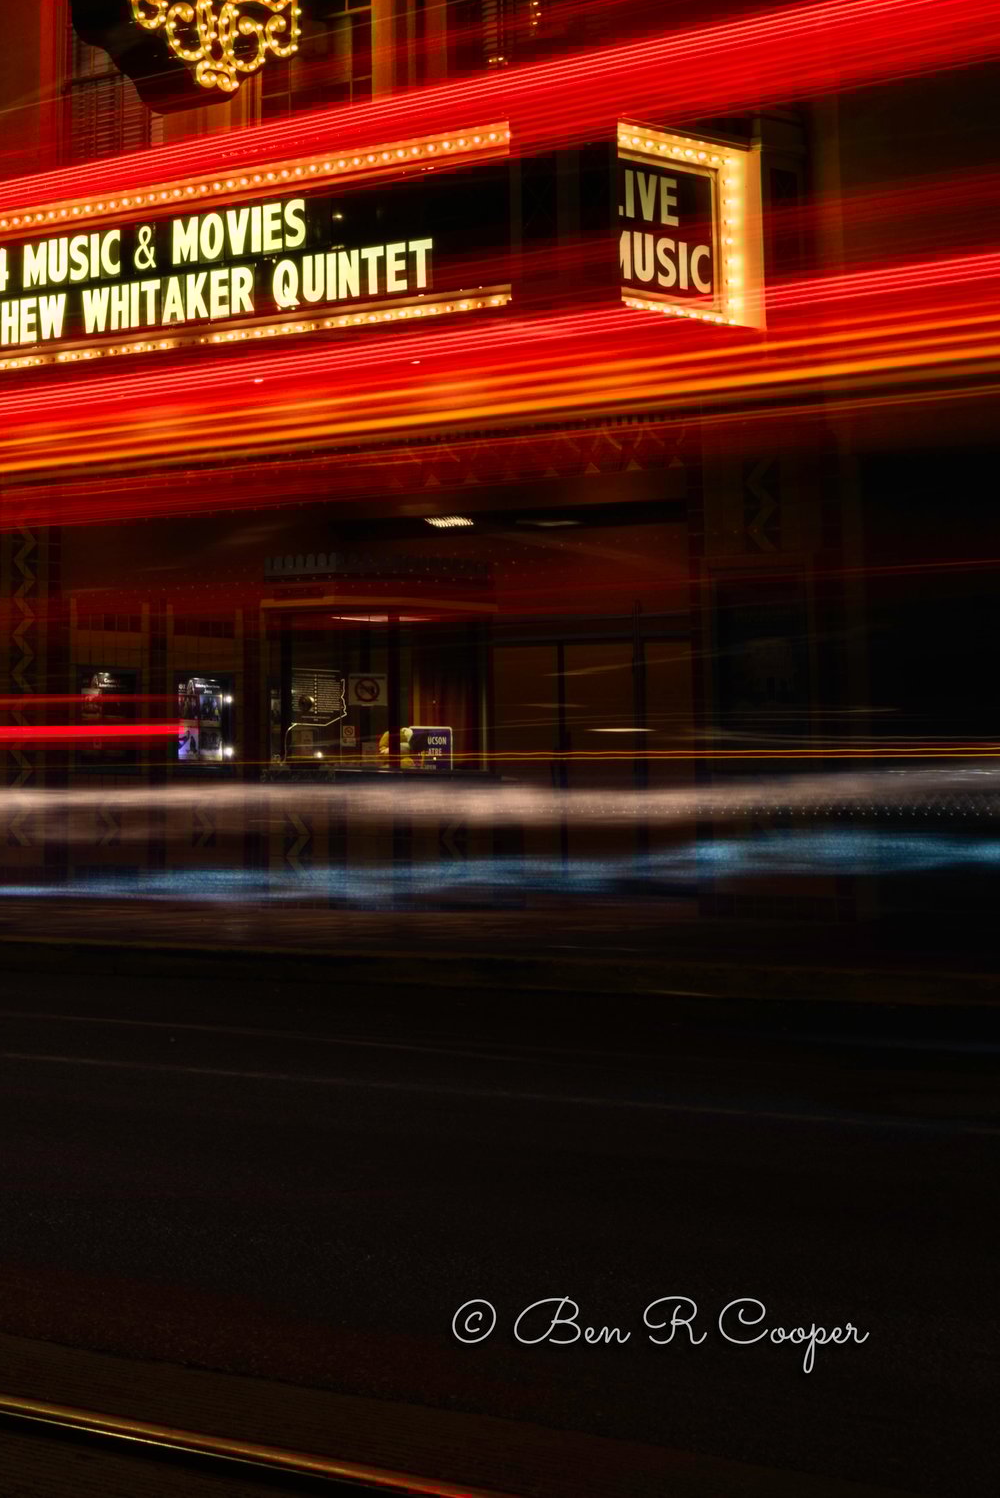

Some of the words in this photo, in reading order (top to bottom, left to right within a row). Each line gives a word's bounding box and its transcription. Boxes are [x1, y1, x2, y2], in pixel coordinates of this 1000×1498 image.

[618, 169, 679, 227] IVE
[23, 230, 121, 286] MUSIC
[134, 225, 157, 269] &
[171, 198, 308, 262] MOVIES
[82, 265, 254, 334] WHITAKER
[272, 239, 434, 310] QUINTET
[427, 736, 447, 745] UCSON
